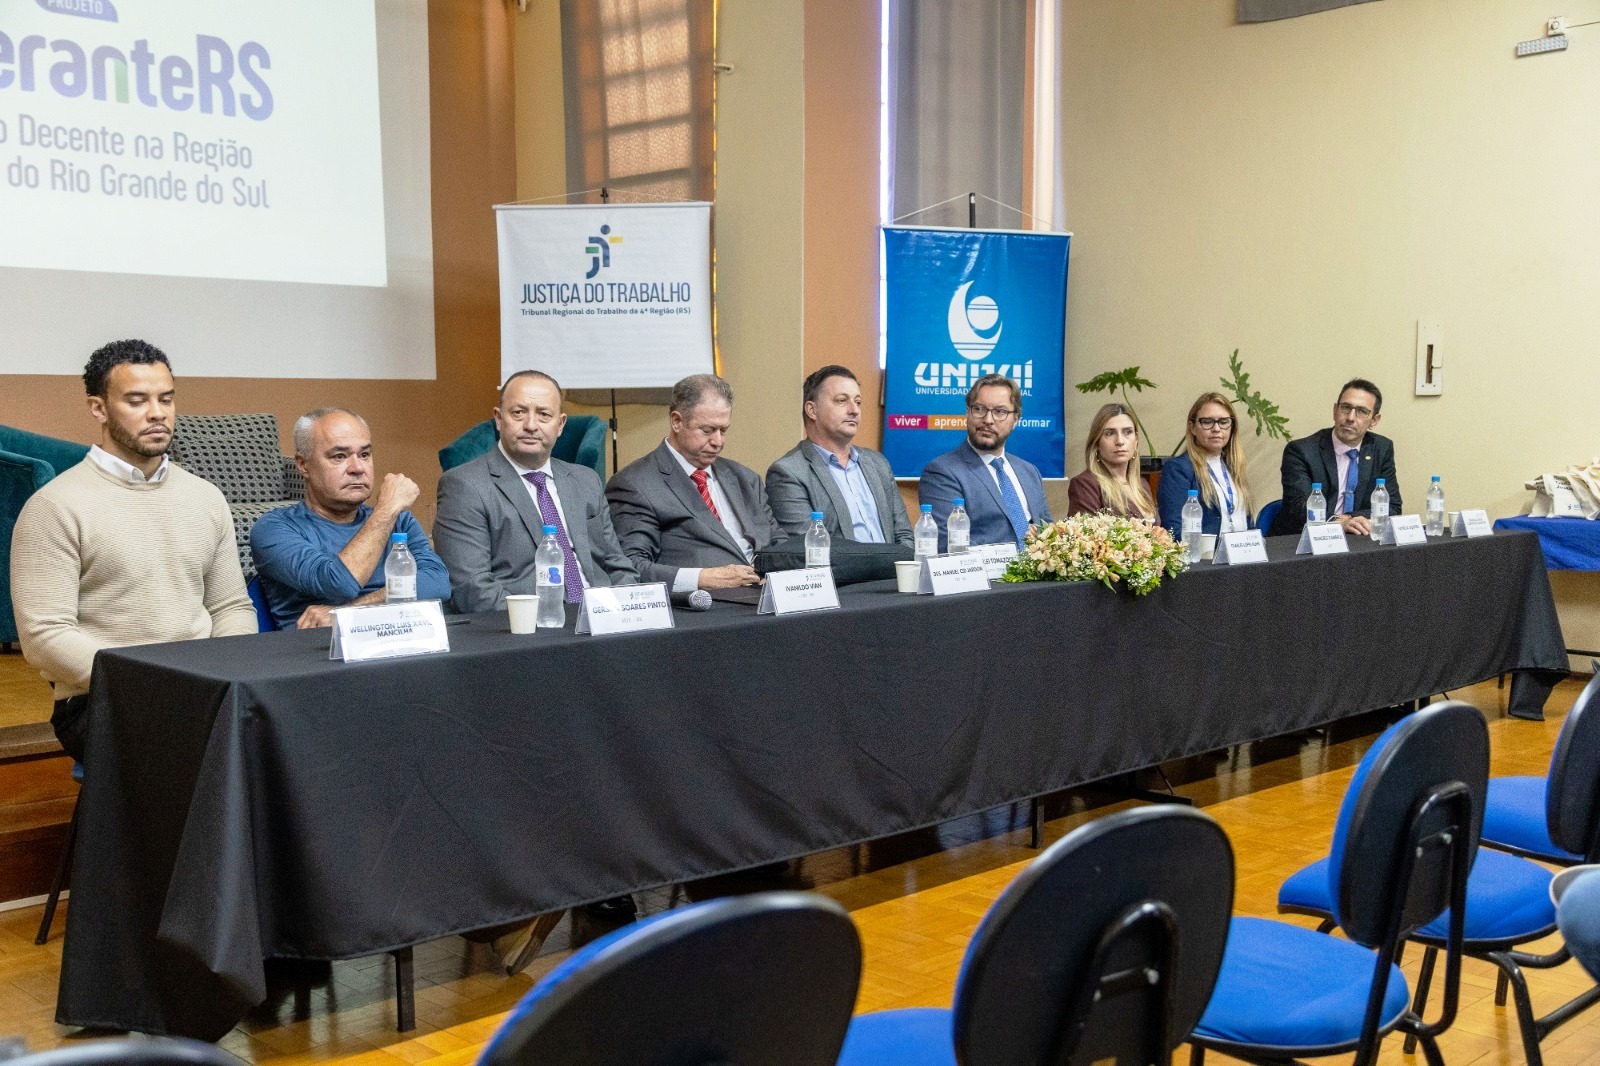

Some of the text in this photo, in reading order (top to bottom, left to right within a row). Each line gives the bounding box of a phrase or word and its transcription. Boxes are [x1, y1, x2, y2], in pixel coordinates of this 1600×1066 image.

[19, 113, 125, 156] Decente
[134, 135, 163, 160] na
[173, 131, 253, 172] Região
[7, 156, 270, 209] do Rio Grande do Sul
[521, 282, 691, 306] JUSTIÇA DO TRABALHO
[521, 308, 551, 316] Tribunal
[552, 308, 584, 317] Regional
[649, 307, 675, 316] Região
[675, 307, 691, 315] (RS)
[915, 387, 971, 395] UNIVERSIDAD
[895, 415, 921, 426] viver
[1016, 417, 1051, 427] formar
[592, 601, 666, 614] GERS SOARES PINTO
[349, 622, 396, 634] WELLINGTON
[396, 621, 412, 629] LUIS
[377, 628, 414, 638] MANCILHA
